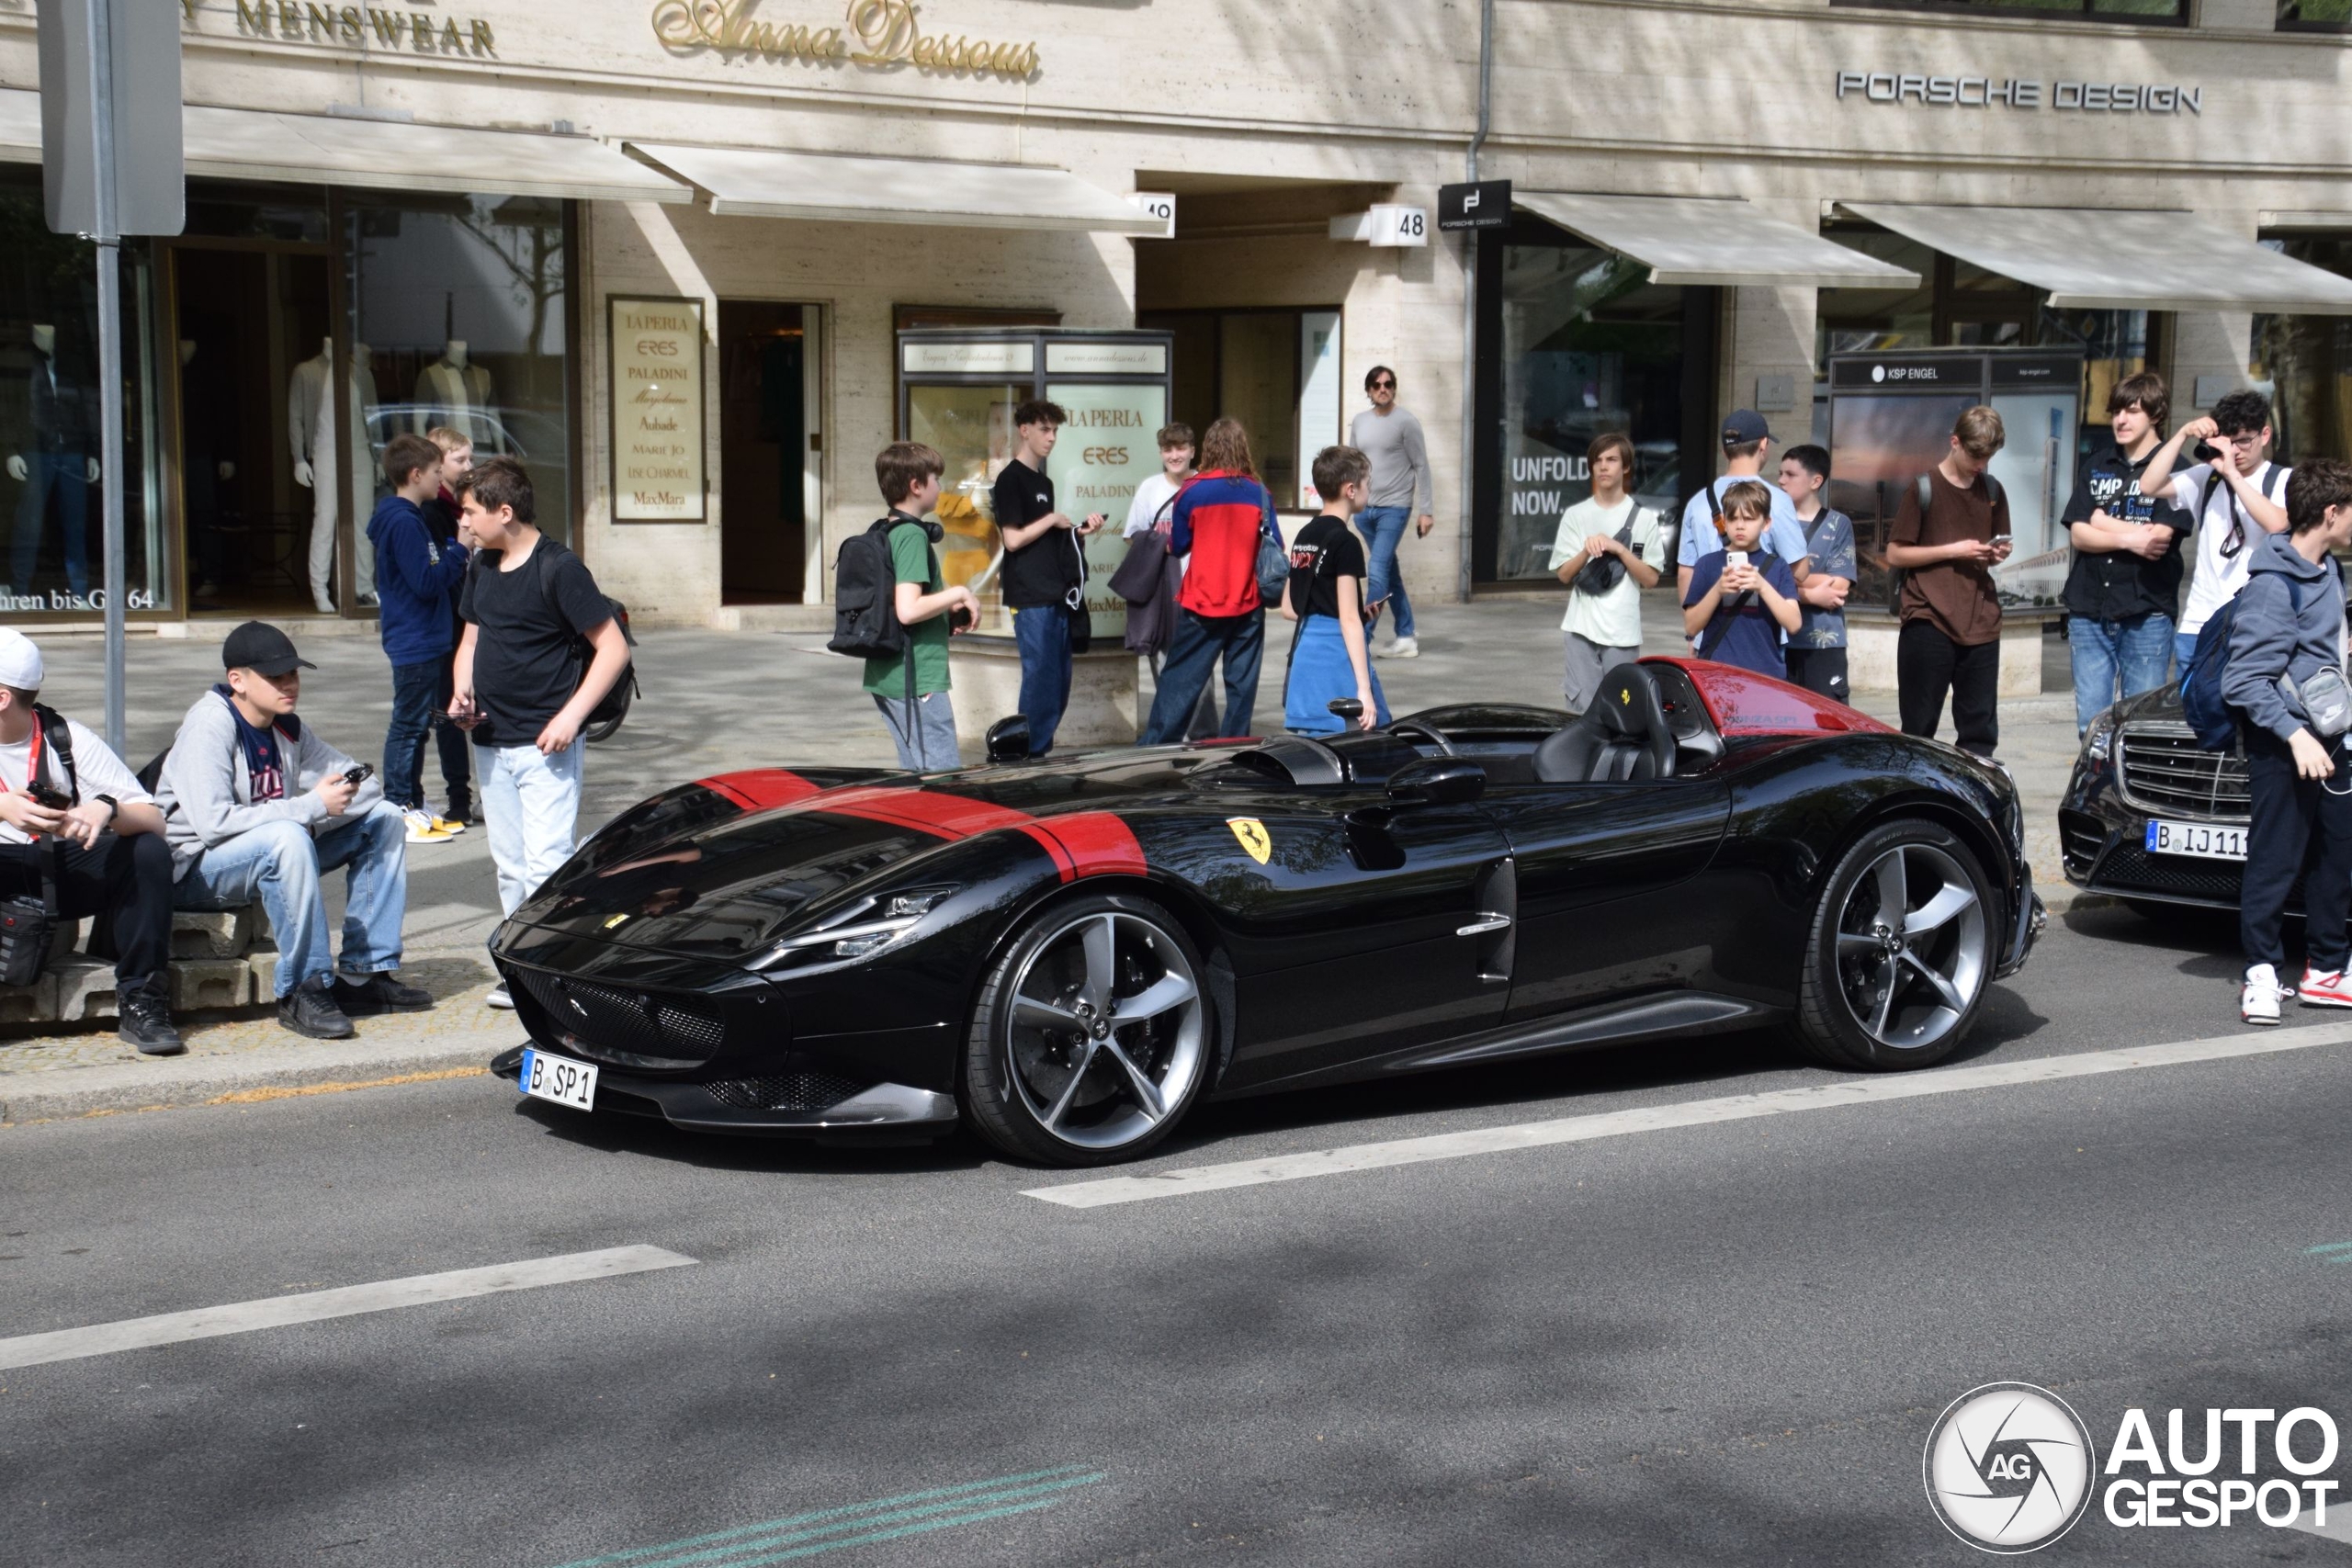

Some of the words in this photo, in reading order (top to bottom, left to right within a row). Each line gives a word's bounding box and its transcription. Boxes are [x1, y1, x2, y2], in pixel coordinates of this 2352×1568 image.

[235, 0, 495, 51] MENSWEAR
[651, 0, 842, 57] Anna
[845, 0, 1036, 73] Dessous
[1838, 71, 2041, 107] PORSCHE
[2053, 82, 2203, 114] DESIGN
[1399, 214, 1424, 237] 48
[1476, 218, 1502, 226] DESIGN
[627, 314, 642, 330] LA
[645, 316, 688, 331] PERLA
[637, 341, 678, 355] ERES
[628, 367, 687, 380] PALADINI
[1888, 367, 1906, 379] KSP
[1908, 368, 1938, 379] ENGEL
[639, 416, 678, 431] Aubade
[1068, 410, 1088, 427] LA
[1091, 409, 1144, 427] PERLA
[632, 444, 667, 456] MARIE
[672, 445, 684, 457] JO
[1082, 446, 1129, 465] ERES
[1512, 457, 1591, 481] UNFOLD
[633, 491, 685, 505] MaxMara
[1076, 485, 1136, 498] PALADINI
[1512, 491, 1564, 515] NOW.
[51, 589, 83, 610] bis
[128, 589, 153, 609] 64
[2158, 825, 2170, 849] B
[531, 1058, 544, 1090] B
